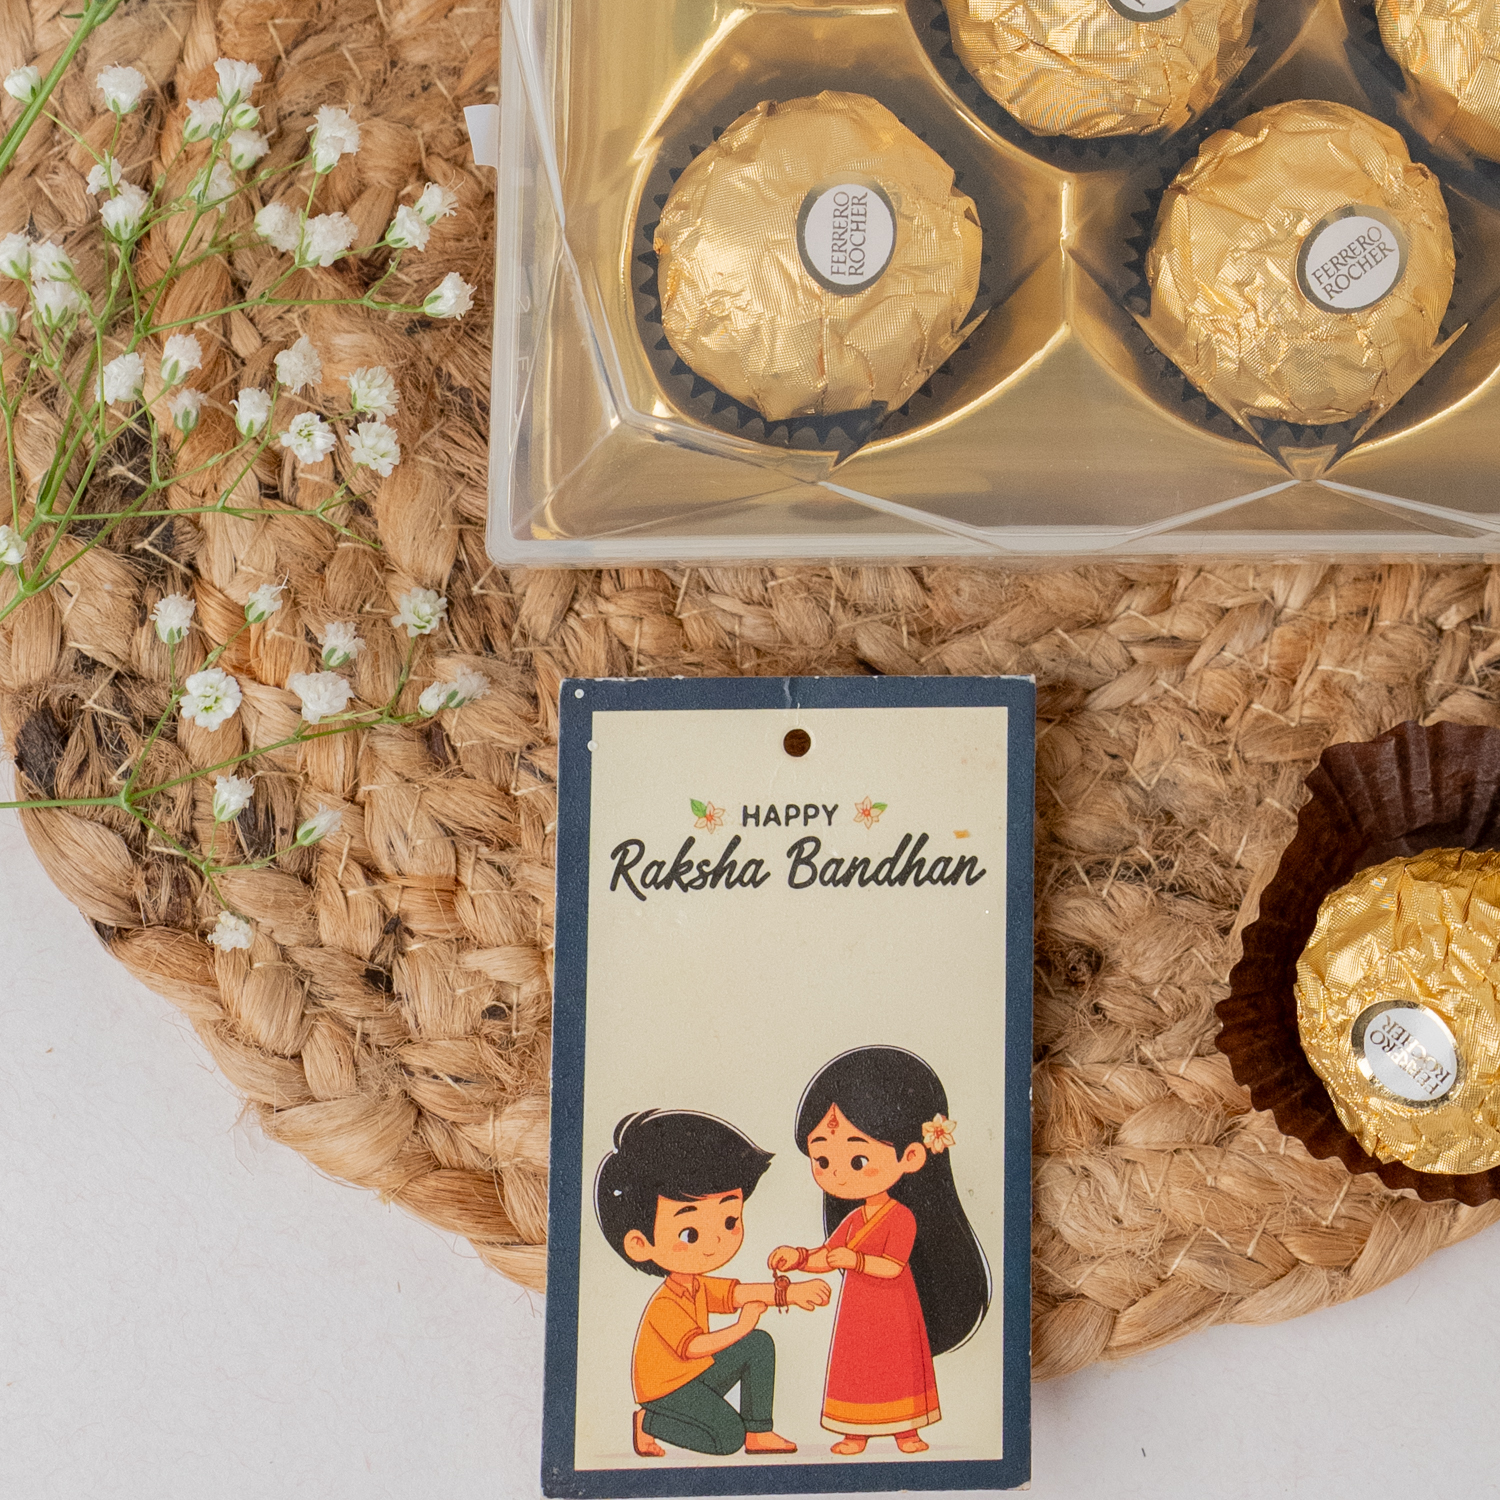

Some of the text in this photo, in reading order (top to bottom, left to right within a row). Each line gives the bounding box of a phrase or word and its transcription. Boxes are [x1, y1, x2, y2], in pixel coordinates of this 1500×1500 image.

[830, 191, 850, 276] FERRERO
[847, 191, 868, 276] ROCHER
[1311, 226, 1383, 287] FERRERO
[1321, 240, 1396, 301] ROCHER
[742, 804, 839, 827] HAPPY
[609, 833, 986, 901] Raksha Bandhan
[1369, 1029, 1440, 1096] FERRERO
[1385, 1014, 1451, 1084] ROCHER
